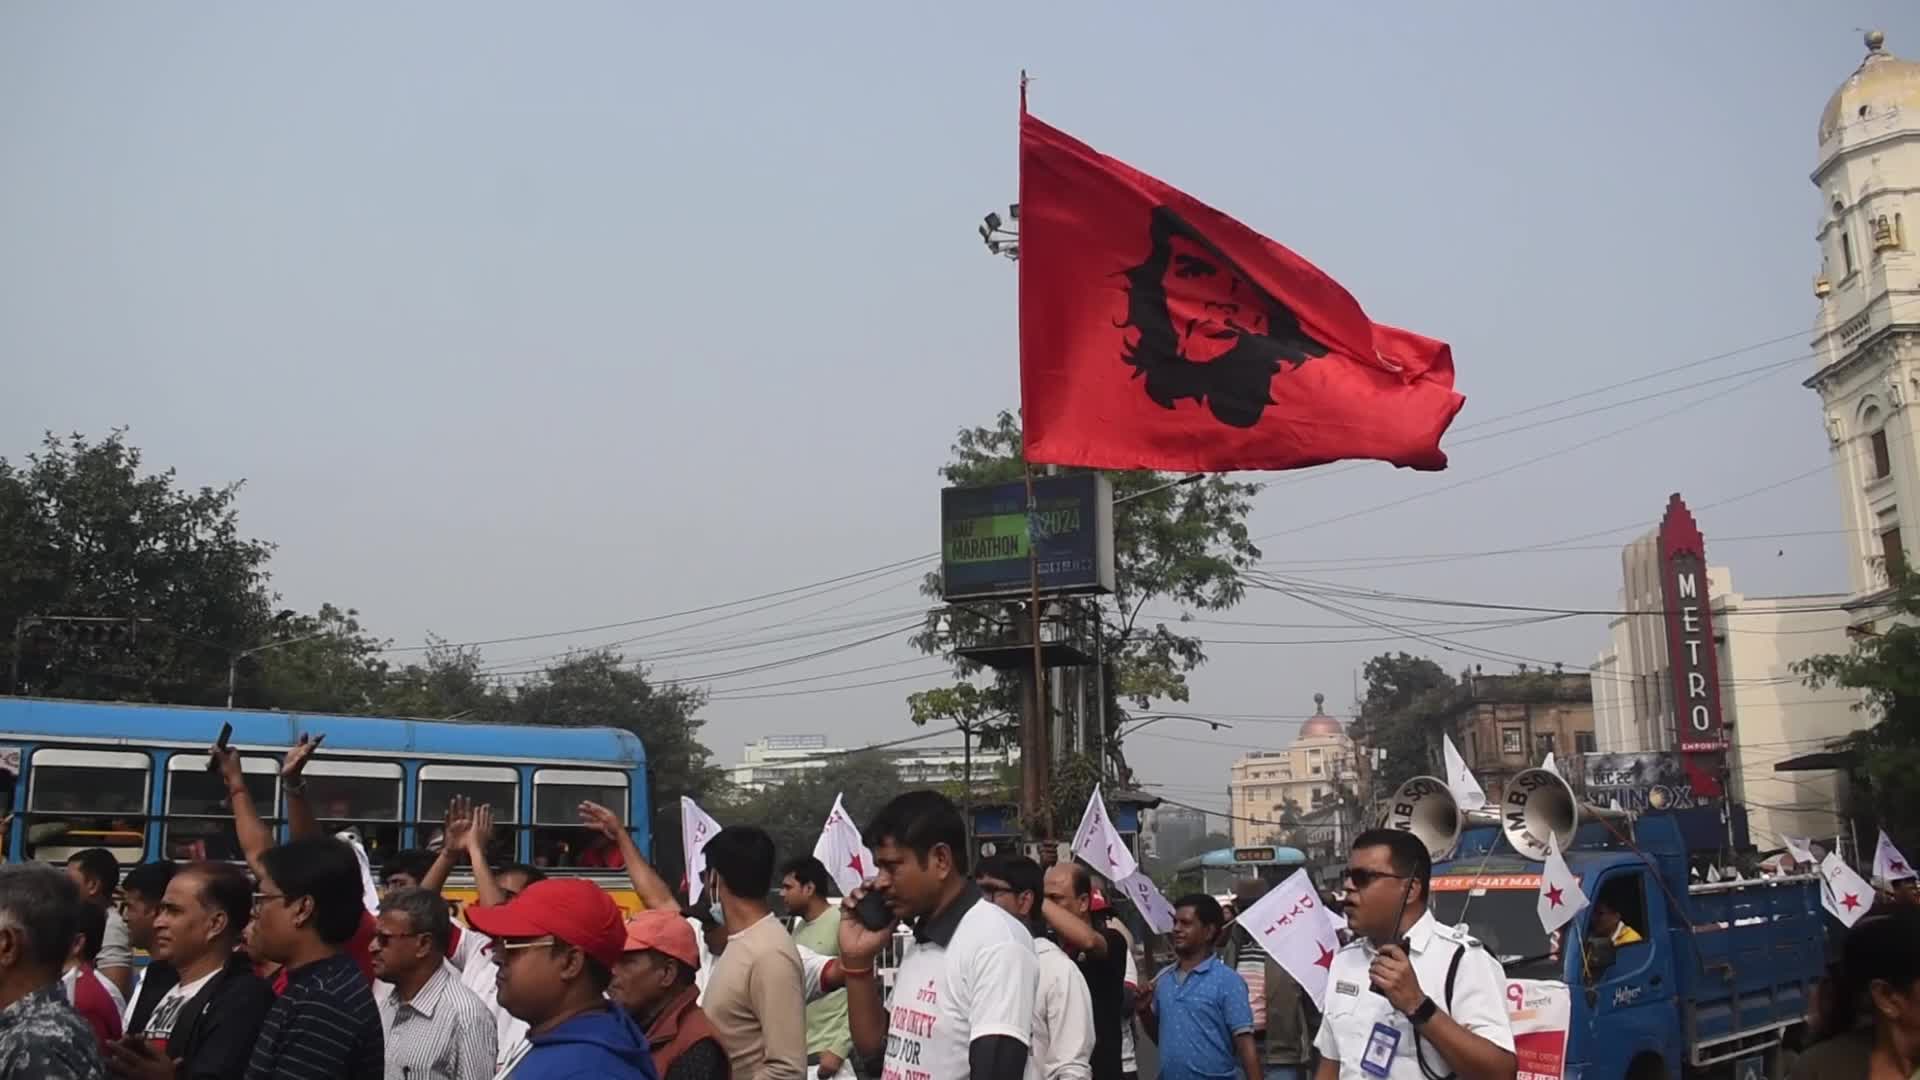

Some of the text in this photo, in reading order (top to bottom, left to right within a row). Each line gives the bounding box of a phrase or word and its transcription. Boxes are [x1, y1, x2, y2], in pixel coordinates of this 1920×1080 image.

[1041, 510, 1081, 534] 2024
[951, 535, 1018, 560] MARATHON
[1678, 574, 1709, 731] METRO
[1593, 772, 1632, 785] DEC 22
[1616, 784, 1695, 809] INOX
[1264, 893, 1314, 935] DYFI
[907, 1009, 937, 1039] UNITY
[899, 1038, 921, 1066] FOR
